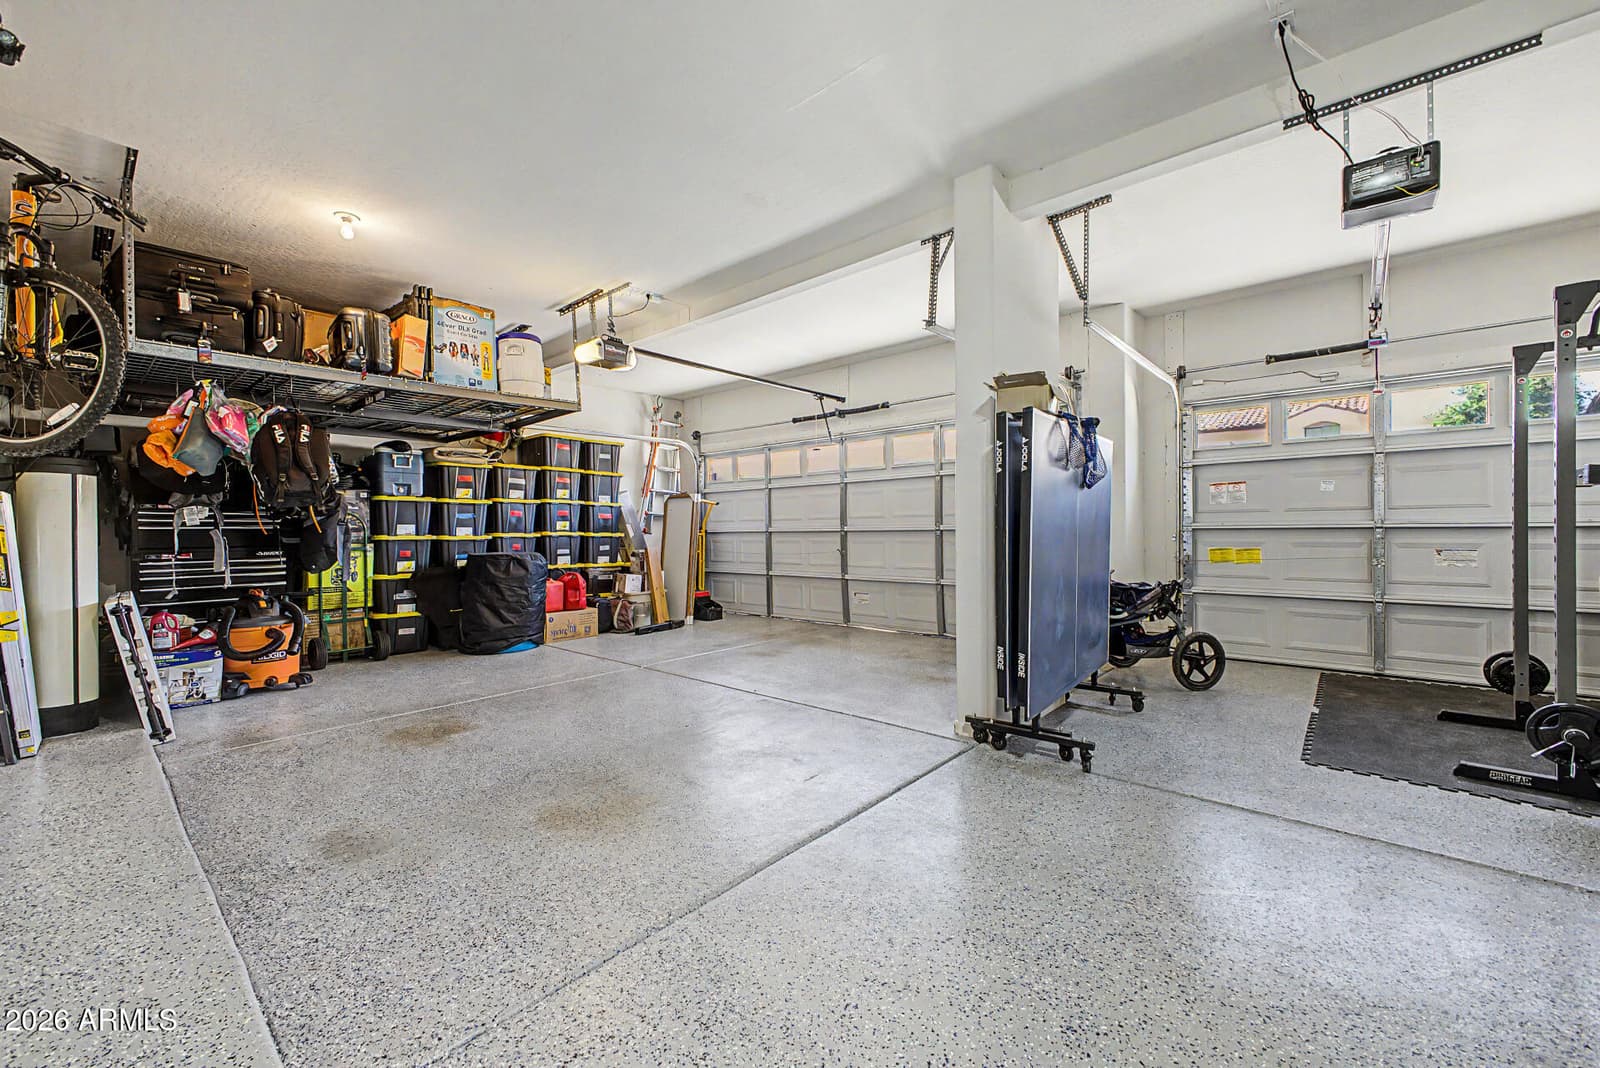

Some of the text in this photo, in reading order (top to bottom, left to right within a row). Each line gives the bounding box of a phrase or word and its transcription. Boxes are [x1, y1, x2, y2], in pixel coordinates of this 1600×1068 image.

[271, 423, 286, 444] FILA
[299, 424, 312, 443] FILA
[1021, 444, 1029, 472] JOOLA
[996, 646, 1004, 671] INSIDE
[1017, 652, 1026, 679] INSIDE
